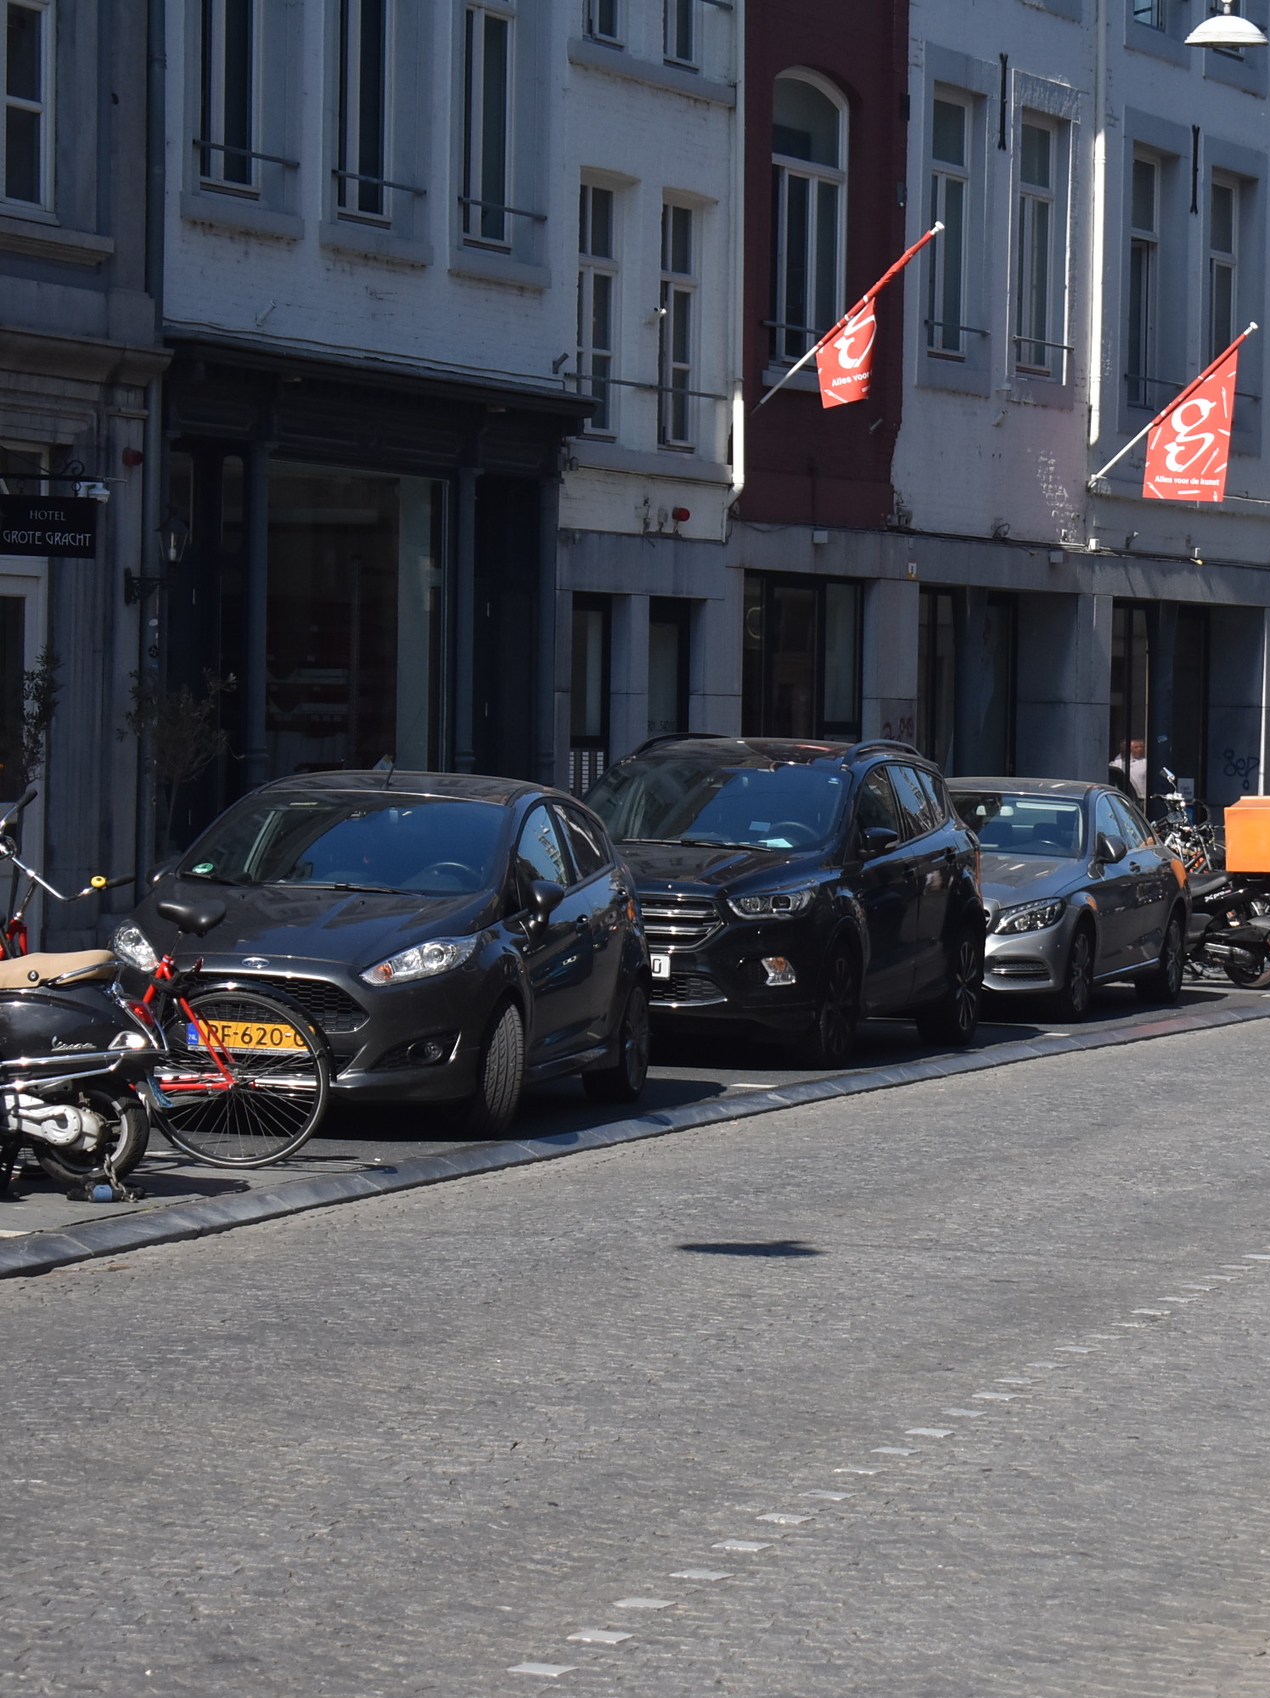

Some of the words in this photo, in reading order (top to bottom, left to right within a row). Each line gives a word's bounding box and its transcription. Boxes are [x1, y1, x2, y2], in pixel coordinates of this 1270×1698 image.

[831, 376, 852, 387] Alles
[853, 372, 870, 381] voor
[1154, 475, 1173, 483] Alles
[1173, 477, 1189, 485] voor
[1190, 477, 1200, 485] de
[1200, 478, 1220, 486] kunst
[29, 510, 66, 521] HOTEL
[2, 530, 42, 545] GROTE
[45, 532, 92, 547] GRACHT
[188, 1033, 198, 1041] NL
